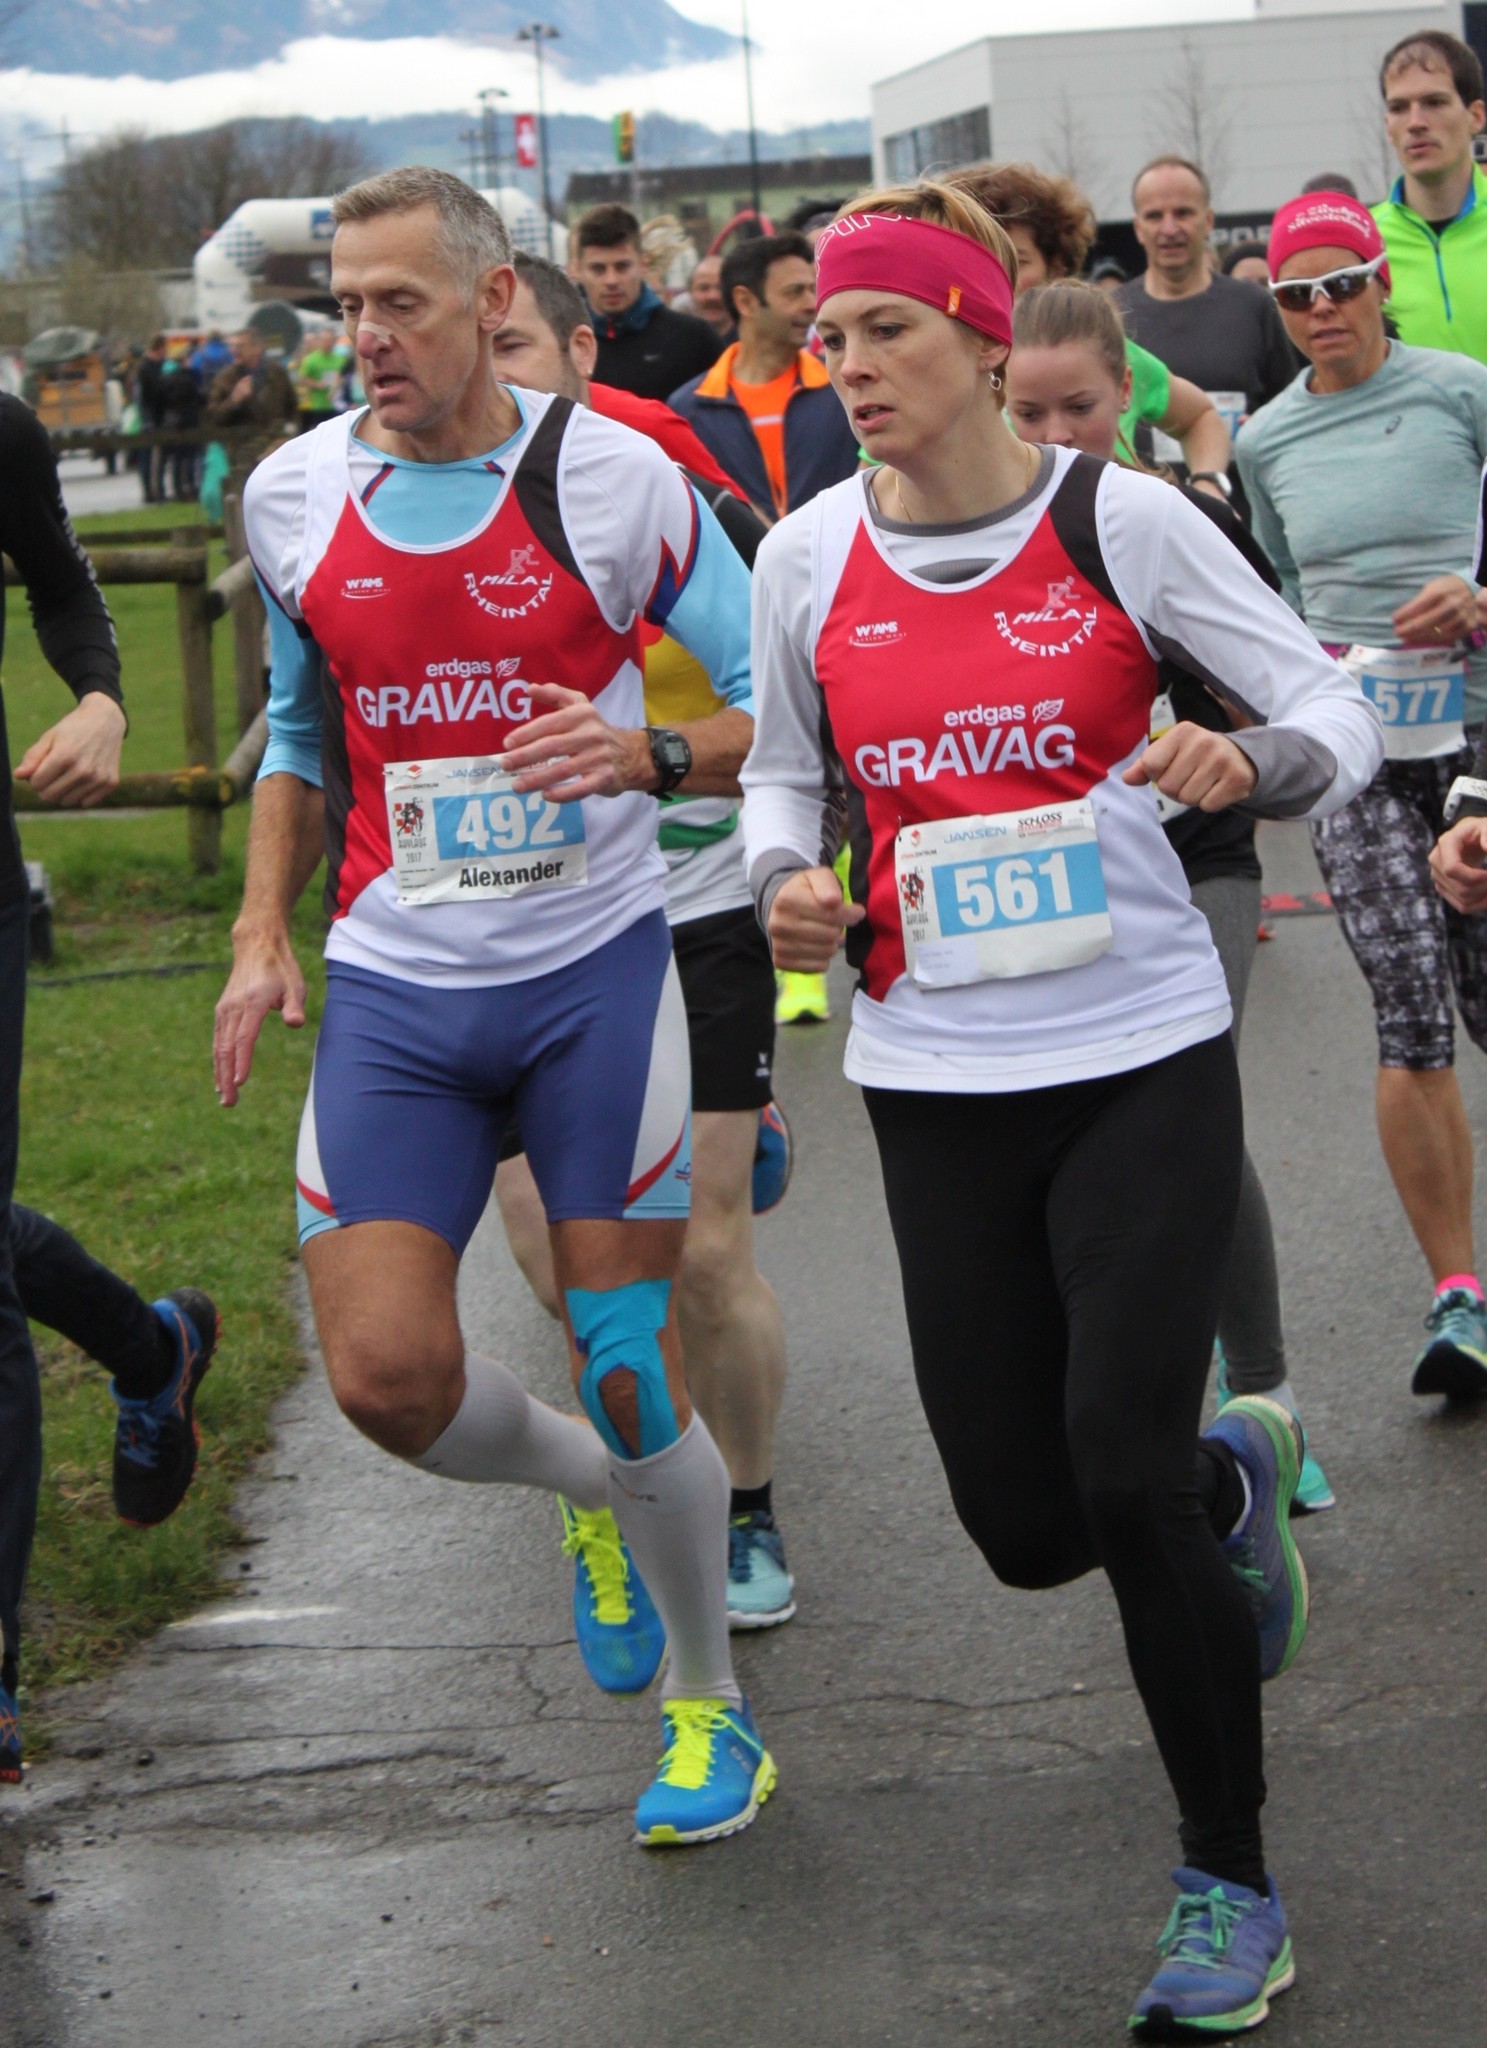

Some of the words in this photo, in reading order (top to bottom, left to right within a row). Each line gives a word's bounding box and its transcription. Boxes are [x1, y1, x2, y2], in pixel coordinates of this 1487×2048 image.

[463, 571, 553, 618] RHEINTAL
[993, 606, 1098, 657] RHEINTAL
[425, 658, 492, 678] erdgas
[355, 679, 533, 728] GRAVAG
[944, 704, 1026, 727] erdgas
[1374, 679, 1451, 723] 577
[446, 766, 500, 779] JANSEN
[854, 723, 1077, 787] GRAVAG
[456, 794, 564, 851] 492
[944, 826, 1008, 844] JANSEN
[406, 852, 422, 864] 2017
[458, 861, 564, 888] Alexander
[954, 852, 1073, 927] 561
